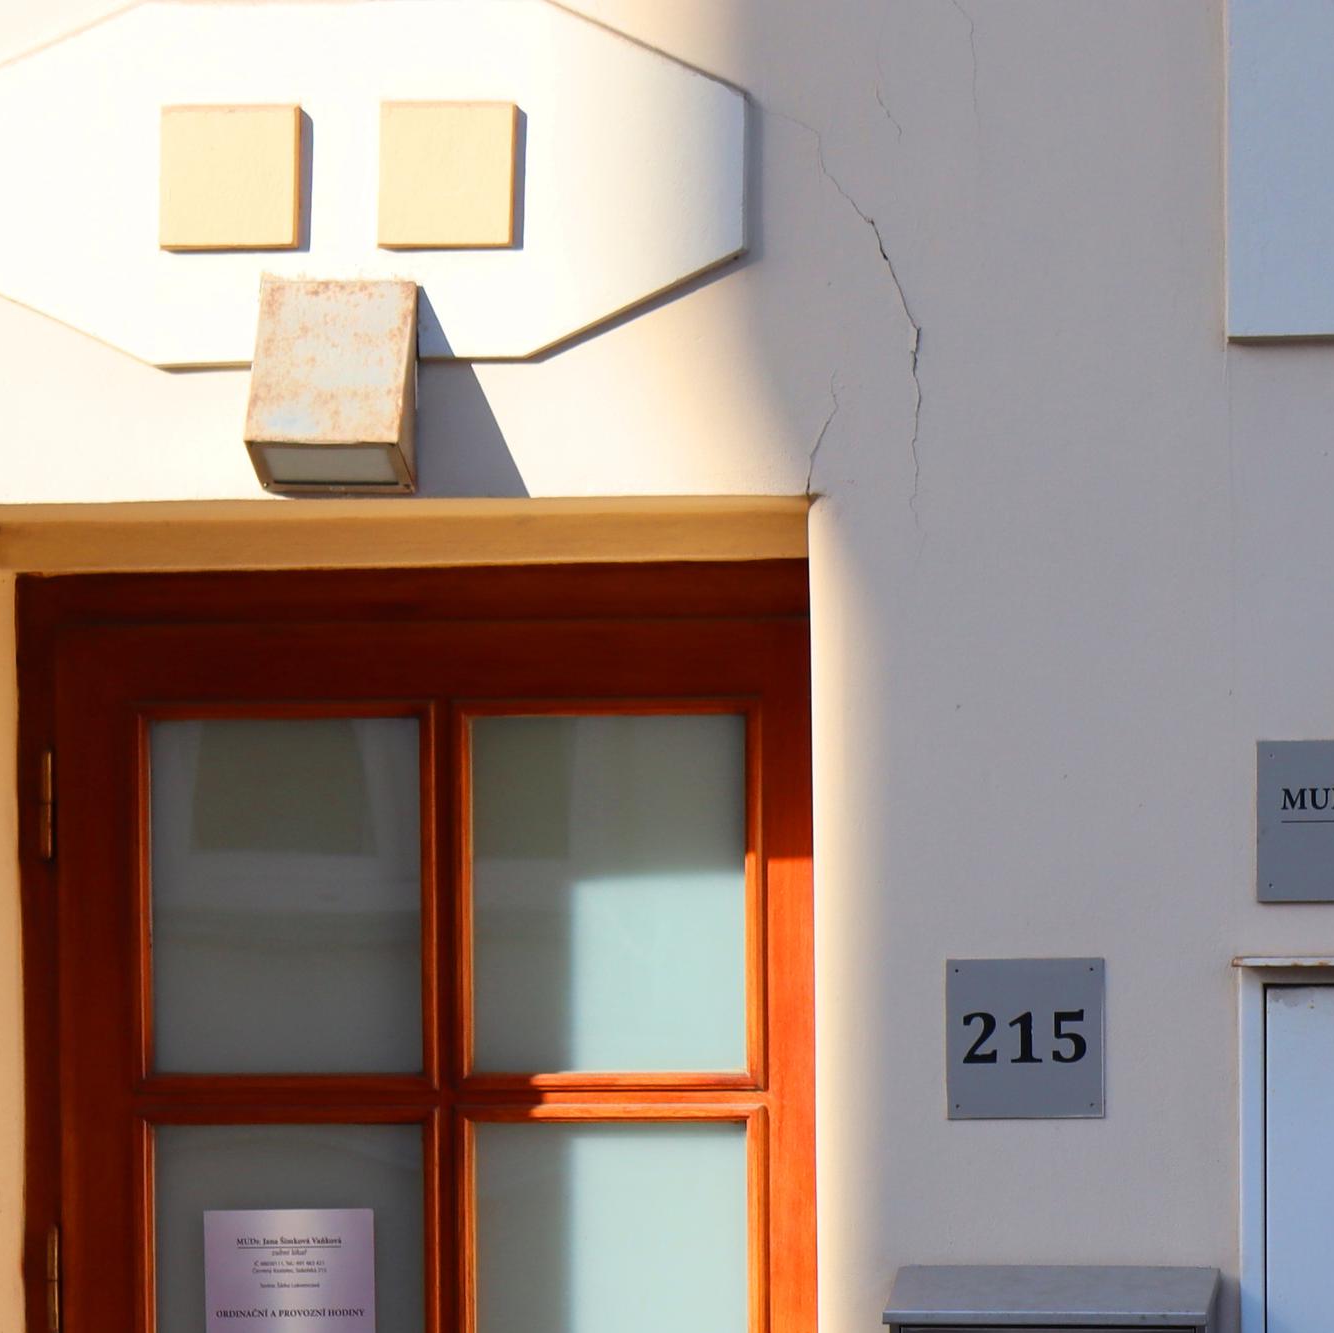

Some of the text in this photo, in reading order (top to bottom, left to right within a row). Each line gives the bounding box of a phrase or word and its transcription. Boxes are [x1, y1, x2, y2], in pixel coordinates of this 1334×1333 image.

[962, 1008, 1087, 1064] 215
[216, 1308, 364, 1318] ORDINAČNÍ A PROVOZNÍ HODINY
